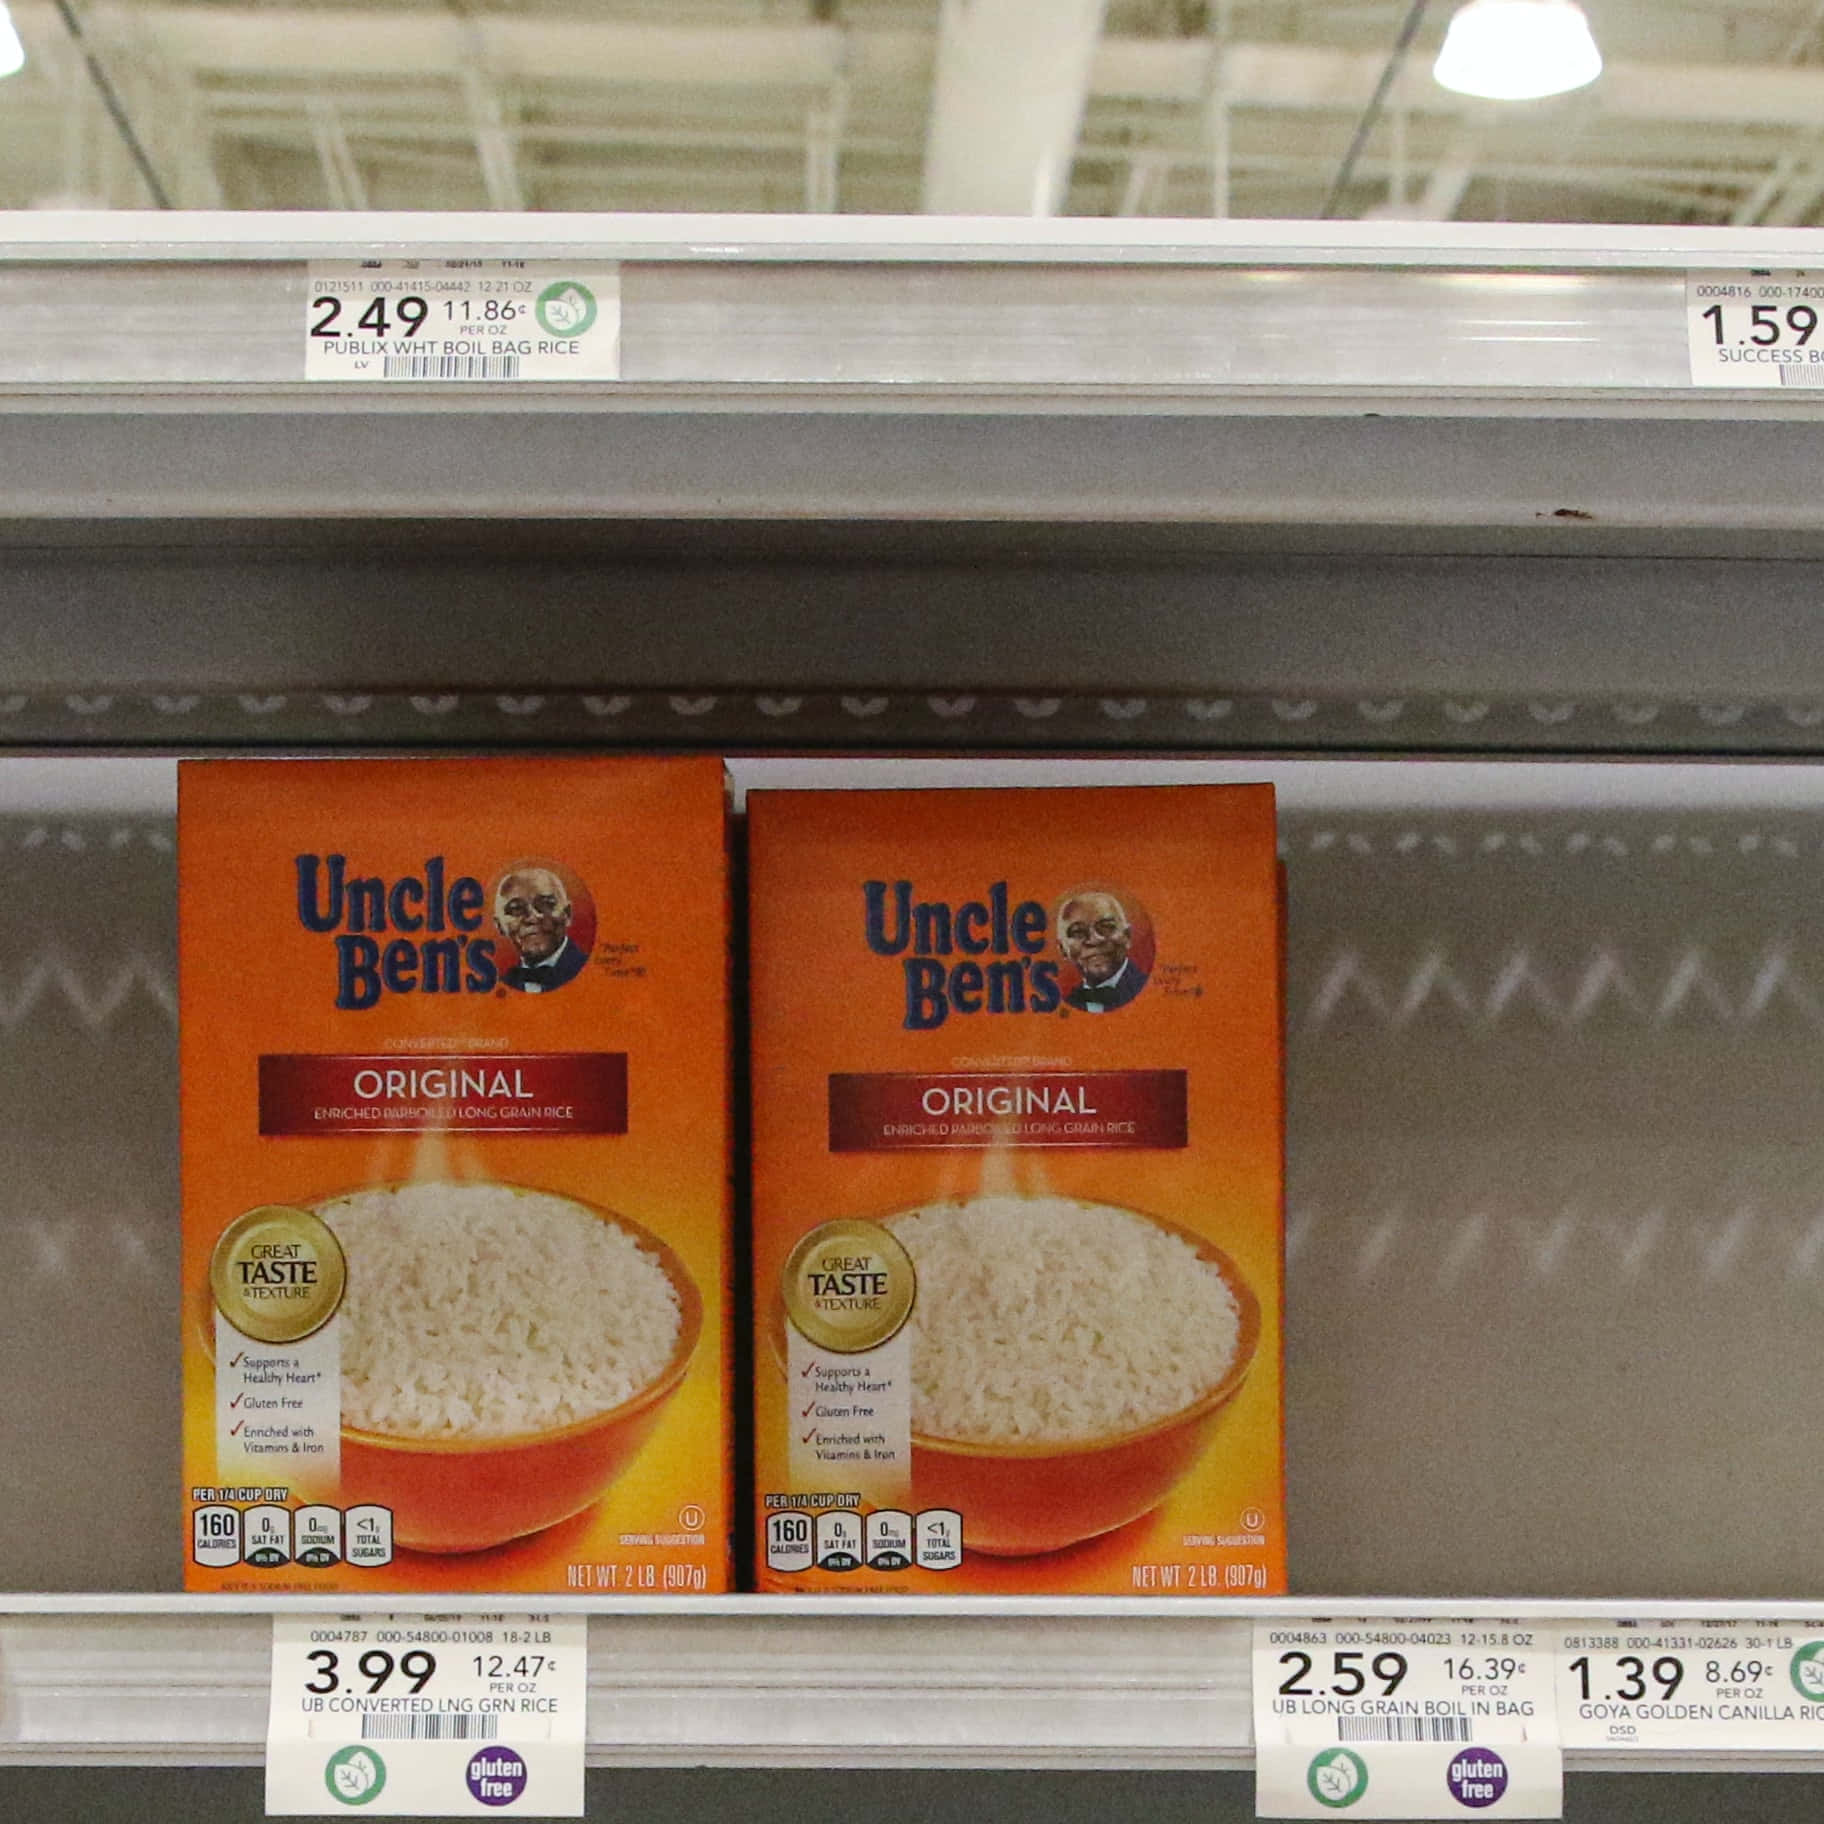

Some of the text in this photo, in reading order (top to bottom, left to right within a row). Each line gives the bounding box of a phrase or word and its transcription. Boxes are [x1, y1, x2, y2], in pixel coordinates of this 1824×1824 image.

[310, 296, 429, 337] 2.49
[443, 300, 526, 320] 11.86¢
[1702, 305, 1818, 346] 1.59
[324, 341, 579, 355] PUBLIX WHT BOIL BAG RICE
[1719, 349, 1803, 364] SUCCESS
[294, 853, 484, 934] Uncle
[862, 880, 1047, 957] Uncle
[335, 934, 498, 1011] Ben's
[902, 956, 1061, 1031] Ben's
[353, 1069, 534, 1101] ORIGINAL
[922, 1087, 1097, 1116] ORIGINAL
[314, 1106, 574, 1120] ENRICHED LONG GRAIN RICE
[251, 1244, 301, 1260] GREAT
[237, 1261, 317, 1285] TASTE
[808, 1273, 889, 1297] TASTE
[243, 1356, 290, 1371] Supports
[243, 1371, 283, 1385] Healthy
[244, 1396, 303, 1409] Gluten Free
[243, 1425, 314, 1438] Enriched with
[243, 1441, 289, 1454] Vitamins
[303, 1442, 324, 1454] Iron
[200, 1513, 234, 1537] 160
[567, 1565, 596, 1586] NET
[598, 1565, 616, 1587] WT
[625, 1565, 634, 1587] 2
[663, 1564, 707, 1589] (907g)
[535, 1632, 551, 1643] LB
[304, 1650, 436, 1694] 3.99
[473, 1656, 556, 1677] 12.47¢
[1278, 1652, 1408, 1696] 2.59
[1444, 1658, 1526, 1680] 16.39¢
[1706, 1661, 1774, 1683] 8.69¢
[1569, 1656, 1684, 1700] 1.39
[301, 1698, 558, 1712] UB CONVERTED LNG GRN RICE
[1272, 1700, 1534, 1716] UB LONG GRAIN BOIL IN BAG
[1579, 1704, 1631, 1720] GOYA
[1636, 1704, 1713, 1720] GOLDEN
[1718, 1705, 1795, 1720] CANILLA
[470, 1757, 522, 1779] gluten
[480, 1779, 512, 1798] free
